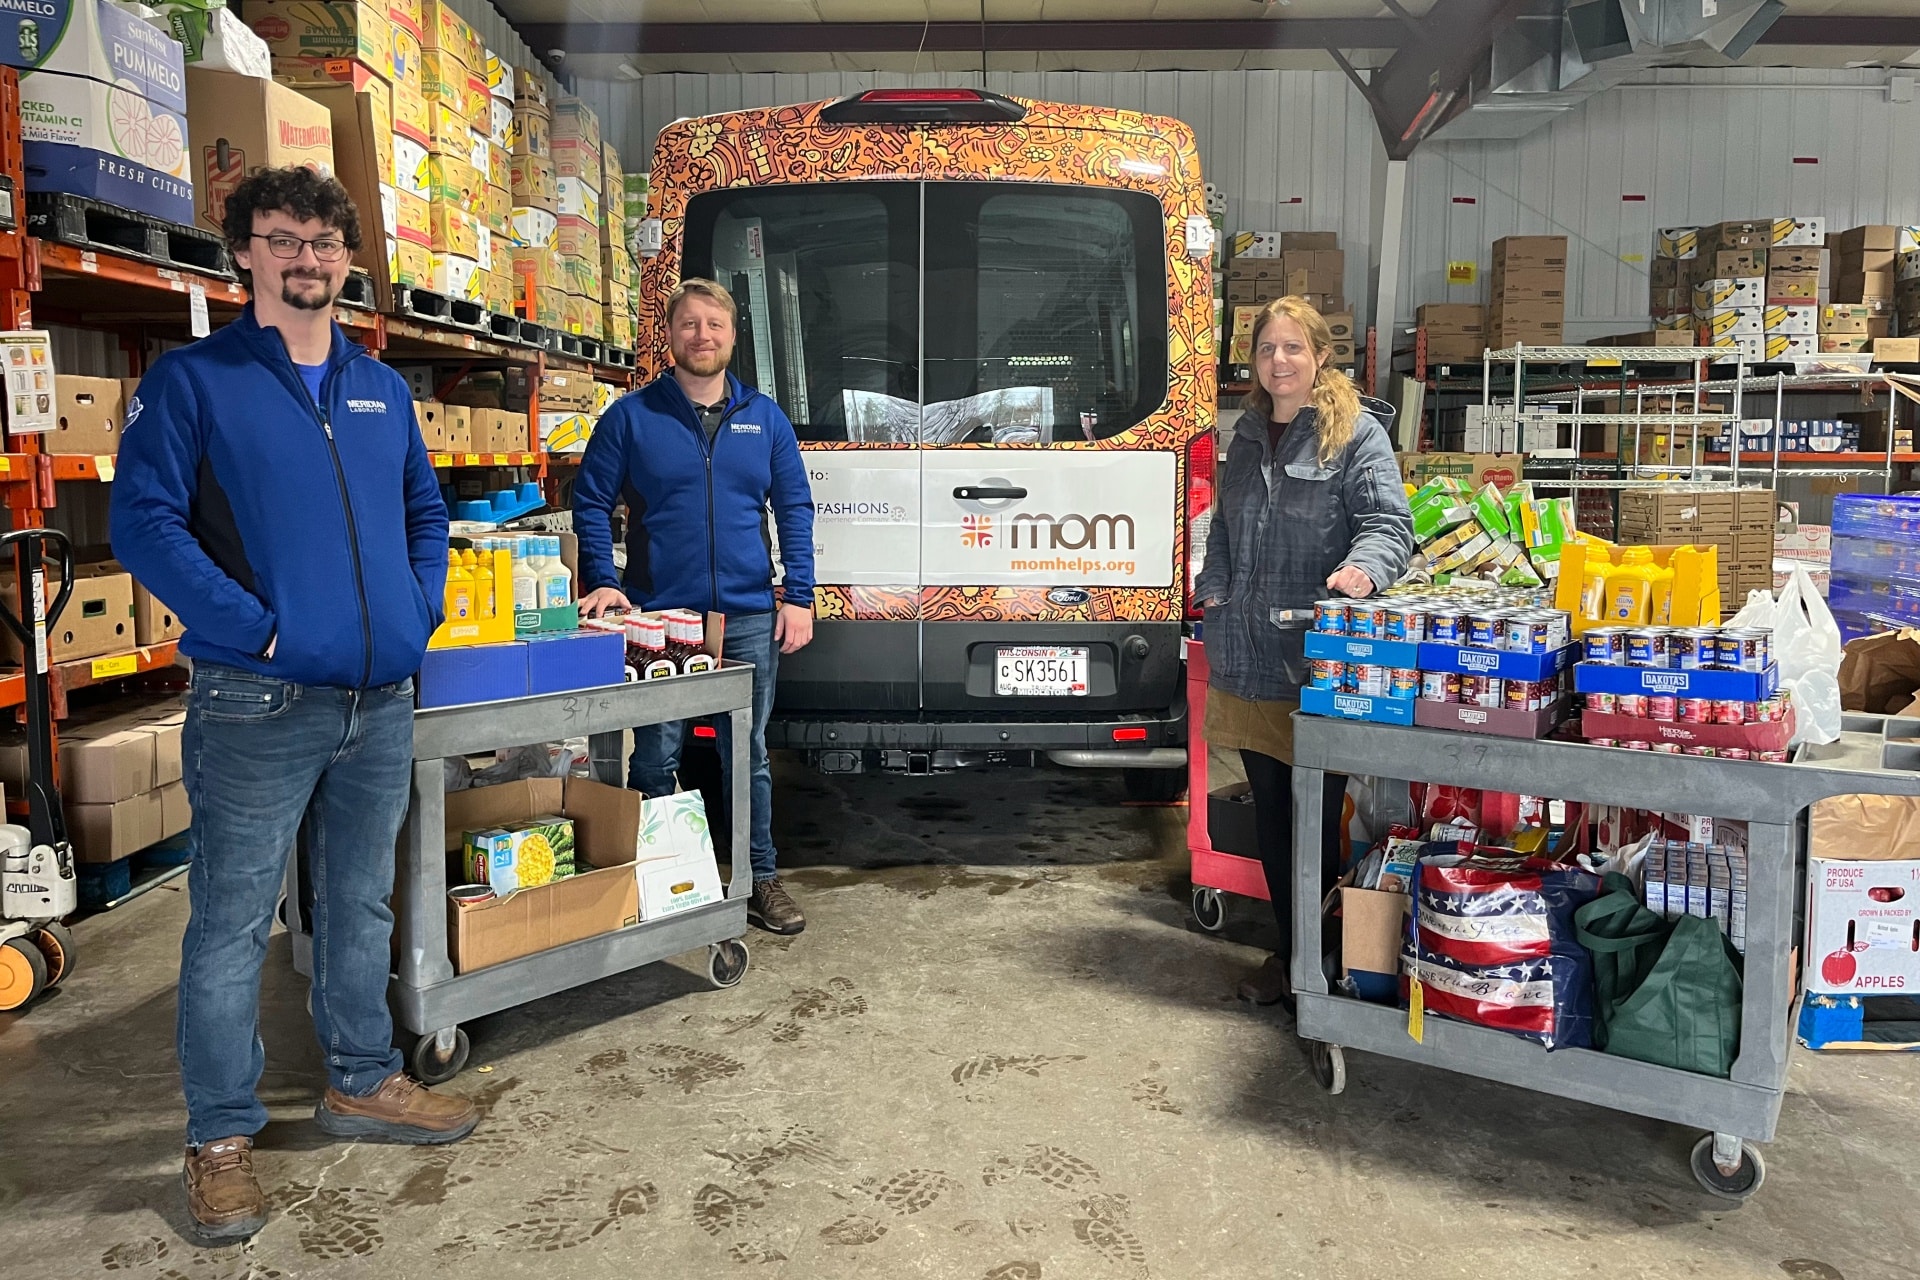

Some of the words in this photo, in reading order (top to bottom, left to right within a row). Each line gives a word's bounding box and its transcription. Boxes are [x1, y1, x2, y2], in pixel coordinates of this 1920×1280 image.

[128, 21, 168, 57] Sunkist
[313, 37, 354, 46] Premium
[113, 42, 180, 92] PUMMELO
[71, 118, 82, 128] C!
[29, 131, 48, 140] Mild
[51, 133, 77, 143] Flavor
[279, 119, 331, 147] WATERMELONS
[99, 158, 145, 184] FRESH
[152, 176, 193, 201] CITRUS
[346, 399, 387, 410] MERIDIAN
[731, 423, 762, 431] MERIDIAN
[809, 469, 829, 481] to:
[817, 502, 889, 515] FASHIONS
[818, 516, 856, 525] Experience
[1011, 513, 1135, 550] mom
[1011, 557, 1136, 575] momhelps.org
[999, 649, 1048, 657] WISCONSIN
[1461, 653, 1496, 666] DAKOTA'S
[1014, 660, 1078, 682] SK3561
[1645, 674, 1685, 686] DAKOTA'S
[1337, 697, 1369, 710] DAKOTA'S
[1659, 726, 1685, 736] Happy
[1827, 868, 1864, 878] PRODUCE
[1826, 879, 1838, 888] OF
[1839, 879, 1854, 888] USA
[1859, 909, 1878, 917] GROWN
[1884, 909, 1904, 917] PACKED
[1905, 909, 1912, 917] BY
[1470, 920, 1522, 939] Free
[1855, 976, 1905, 988] APPLES
